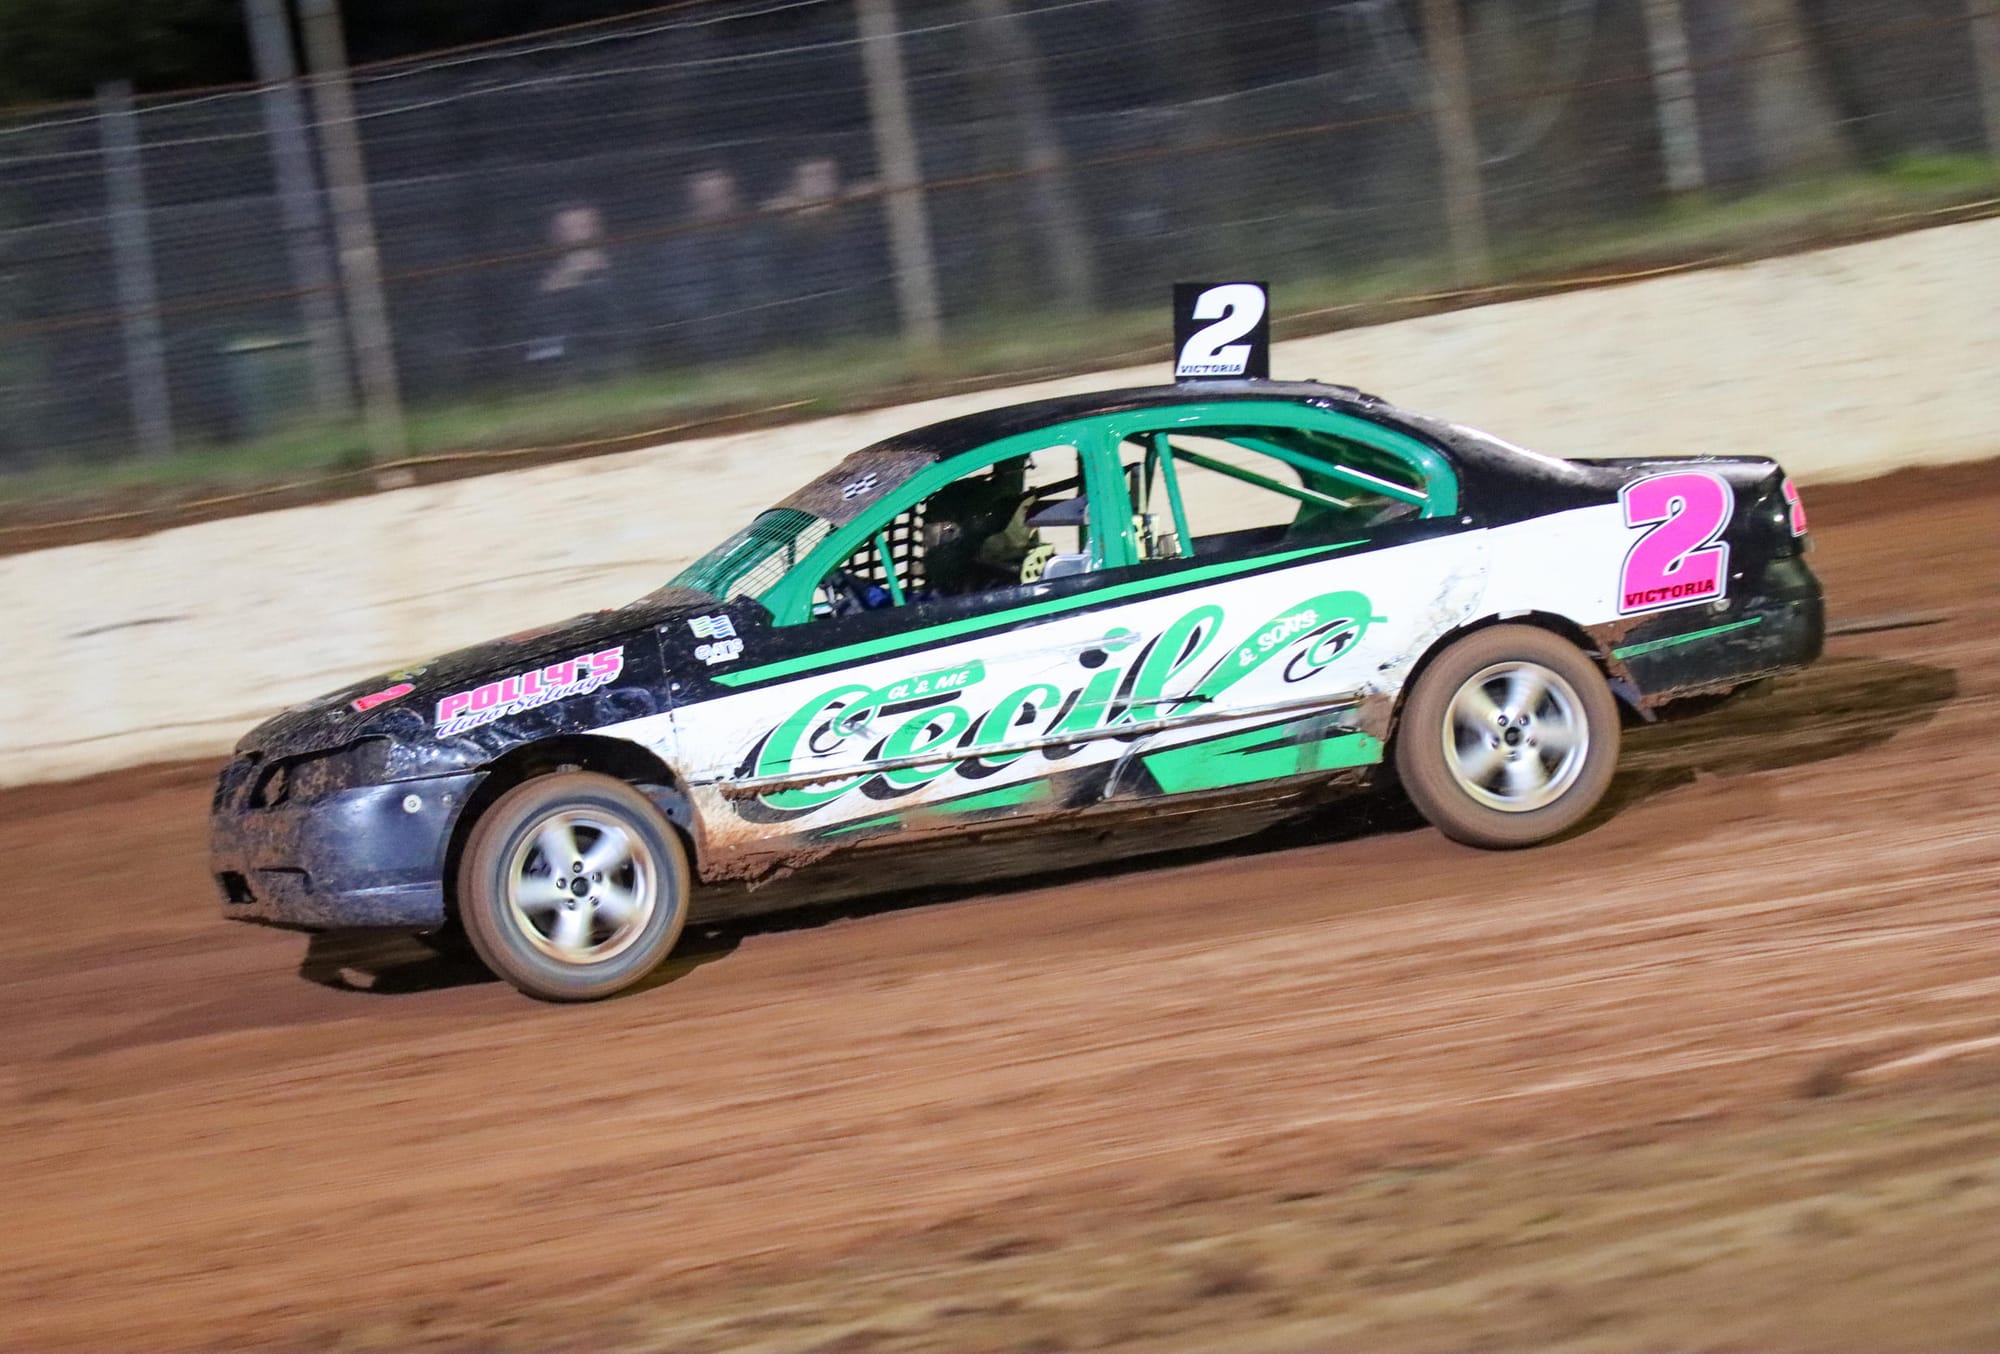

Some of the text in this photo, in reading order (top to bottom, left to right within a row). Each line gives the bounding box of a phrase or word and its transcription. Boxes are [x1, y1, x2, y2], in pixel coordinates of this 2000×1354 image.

[1175, 284, 1266, 376] 2
[1180, 364, 1242, 373] VICTORIA
[1619, 471, 1733, 614] 2
[1626, 579, 1715, 606] VICTORIA
[1257, 609, 1320, 652] SONS
[438, 648, 622, 723] POLLY'S
[438, 671, 617, 737] Auto Salvage
[935, 669, 970, 690] ME
[735, 603, 1224, 824] Cecil
